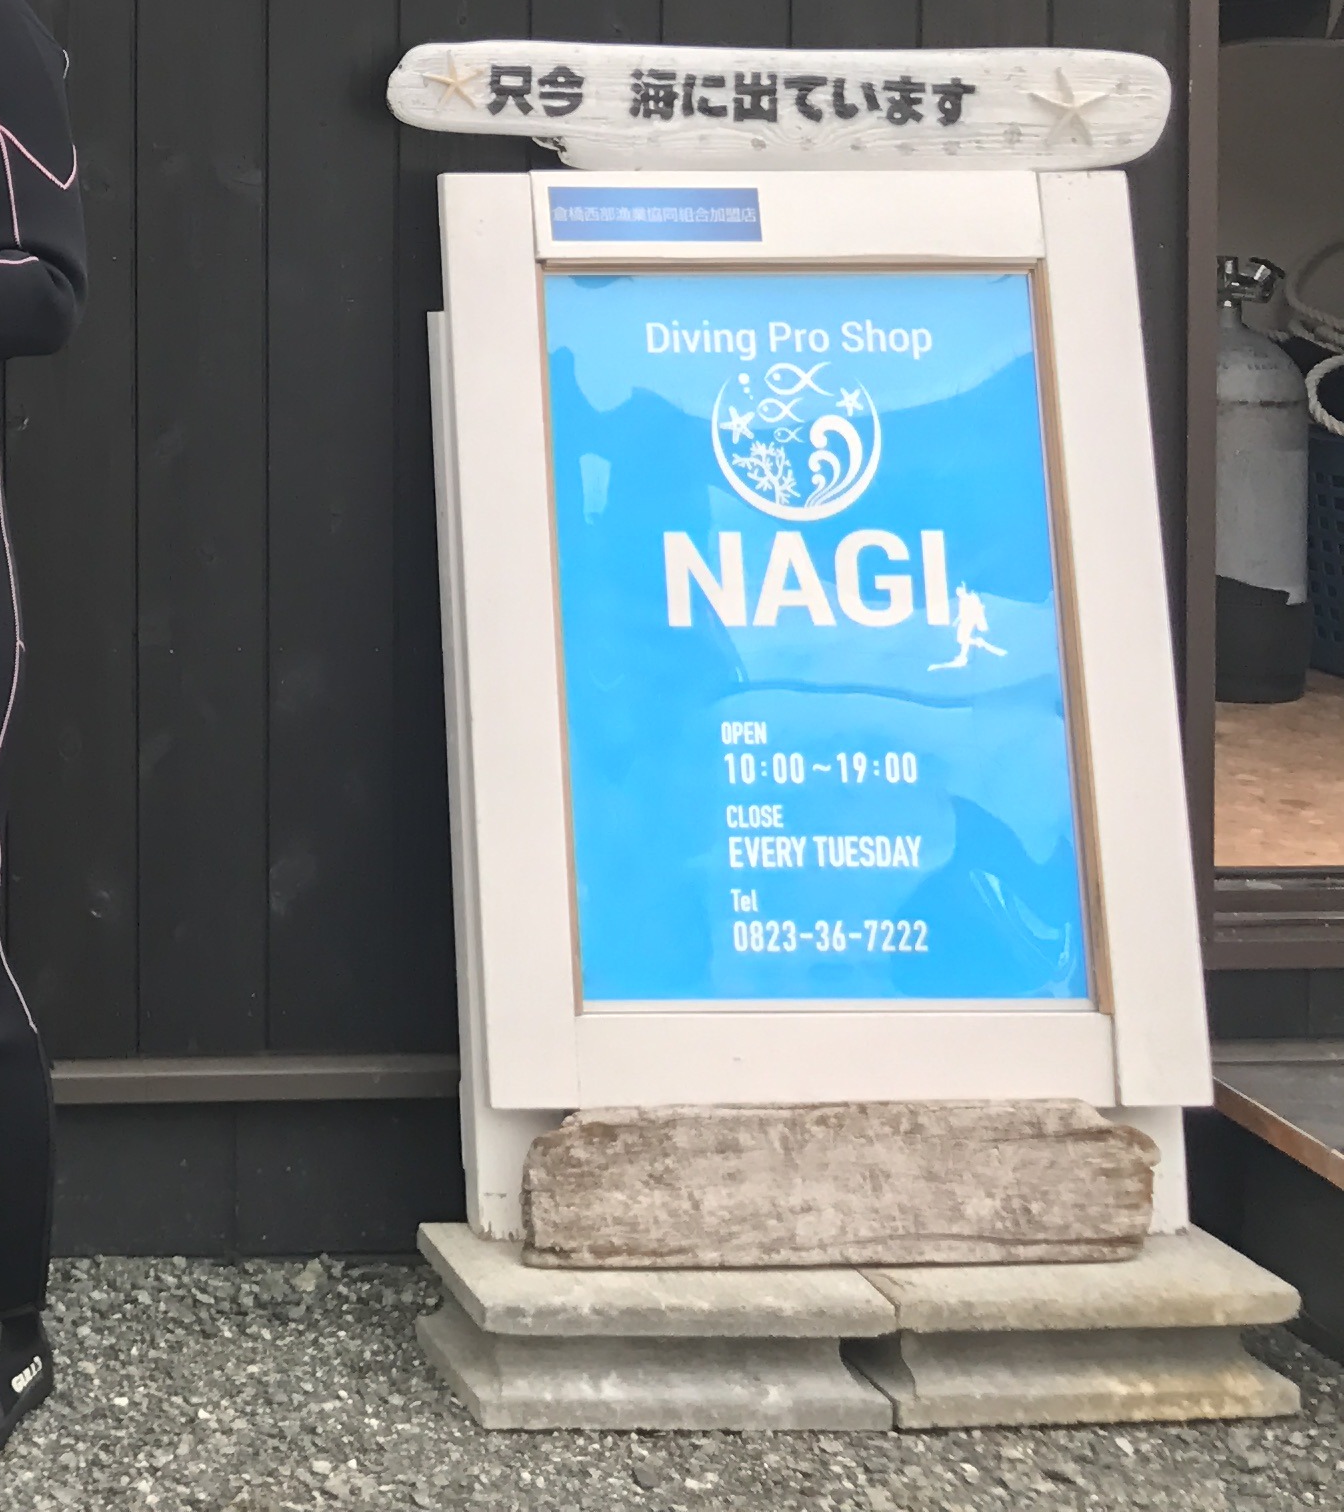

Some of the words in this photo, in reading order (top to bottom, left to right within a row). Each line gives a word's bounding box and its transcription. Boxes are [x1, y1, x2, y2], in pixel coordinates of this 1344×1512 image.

[487, 65, 585, 118] 只今
[629, 68, 977, 127] 海に出ています
[646, 320, 757, 359] Diving
[768, 321, 830, 353] Pro
[841, 319, 933, 359] Shop
[663, 529, 951, 628] NAGI
[721, 721, 767, 745] OPEN
[726, 805, 784, 829] CLOSE
[728, 836, 807, 868] EVERY
[813, 835, 922, 868] TUESDAY
[730, 888, 759, 913] Tel
[733, 919, 929, 953] 0823-36-7222
